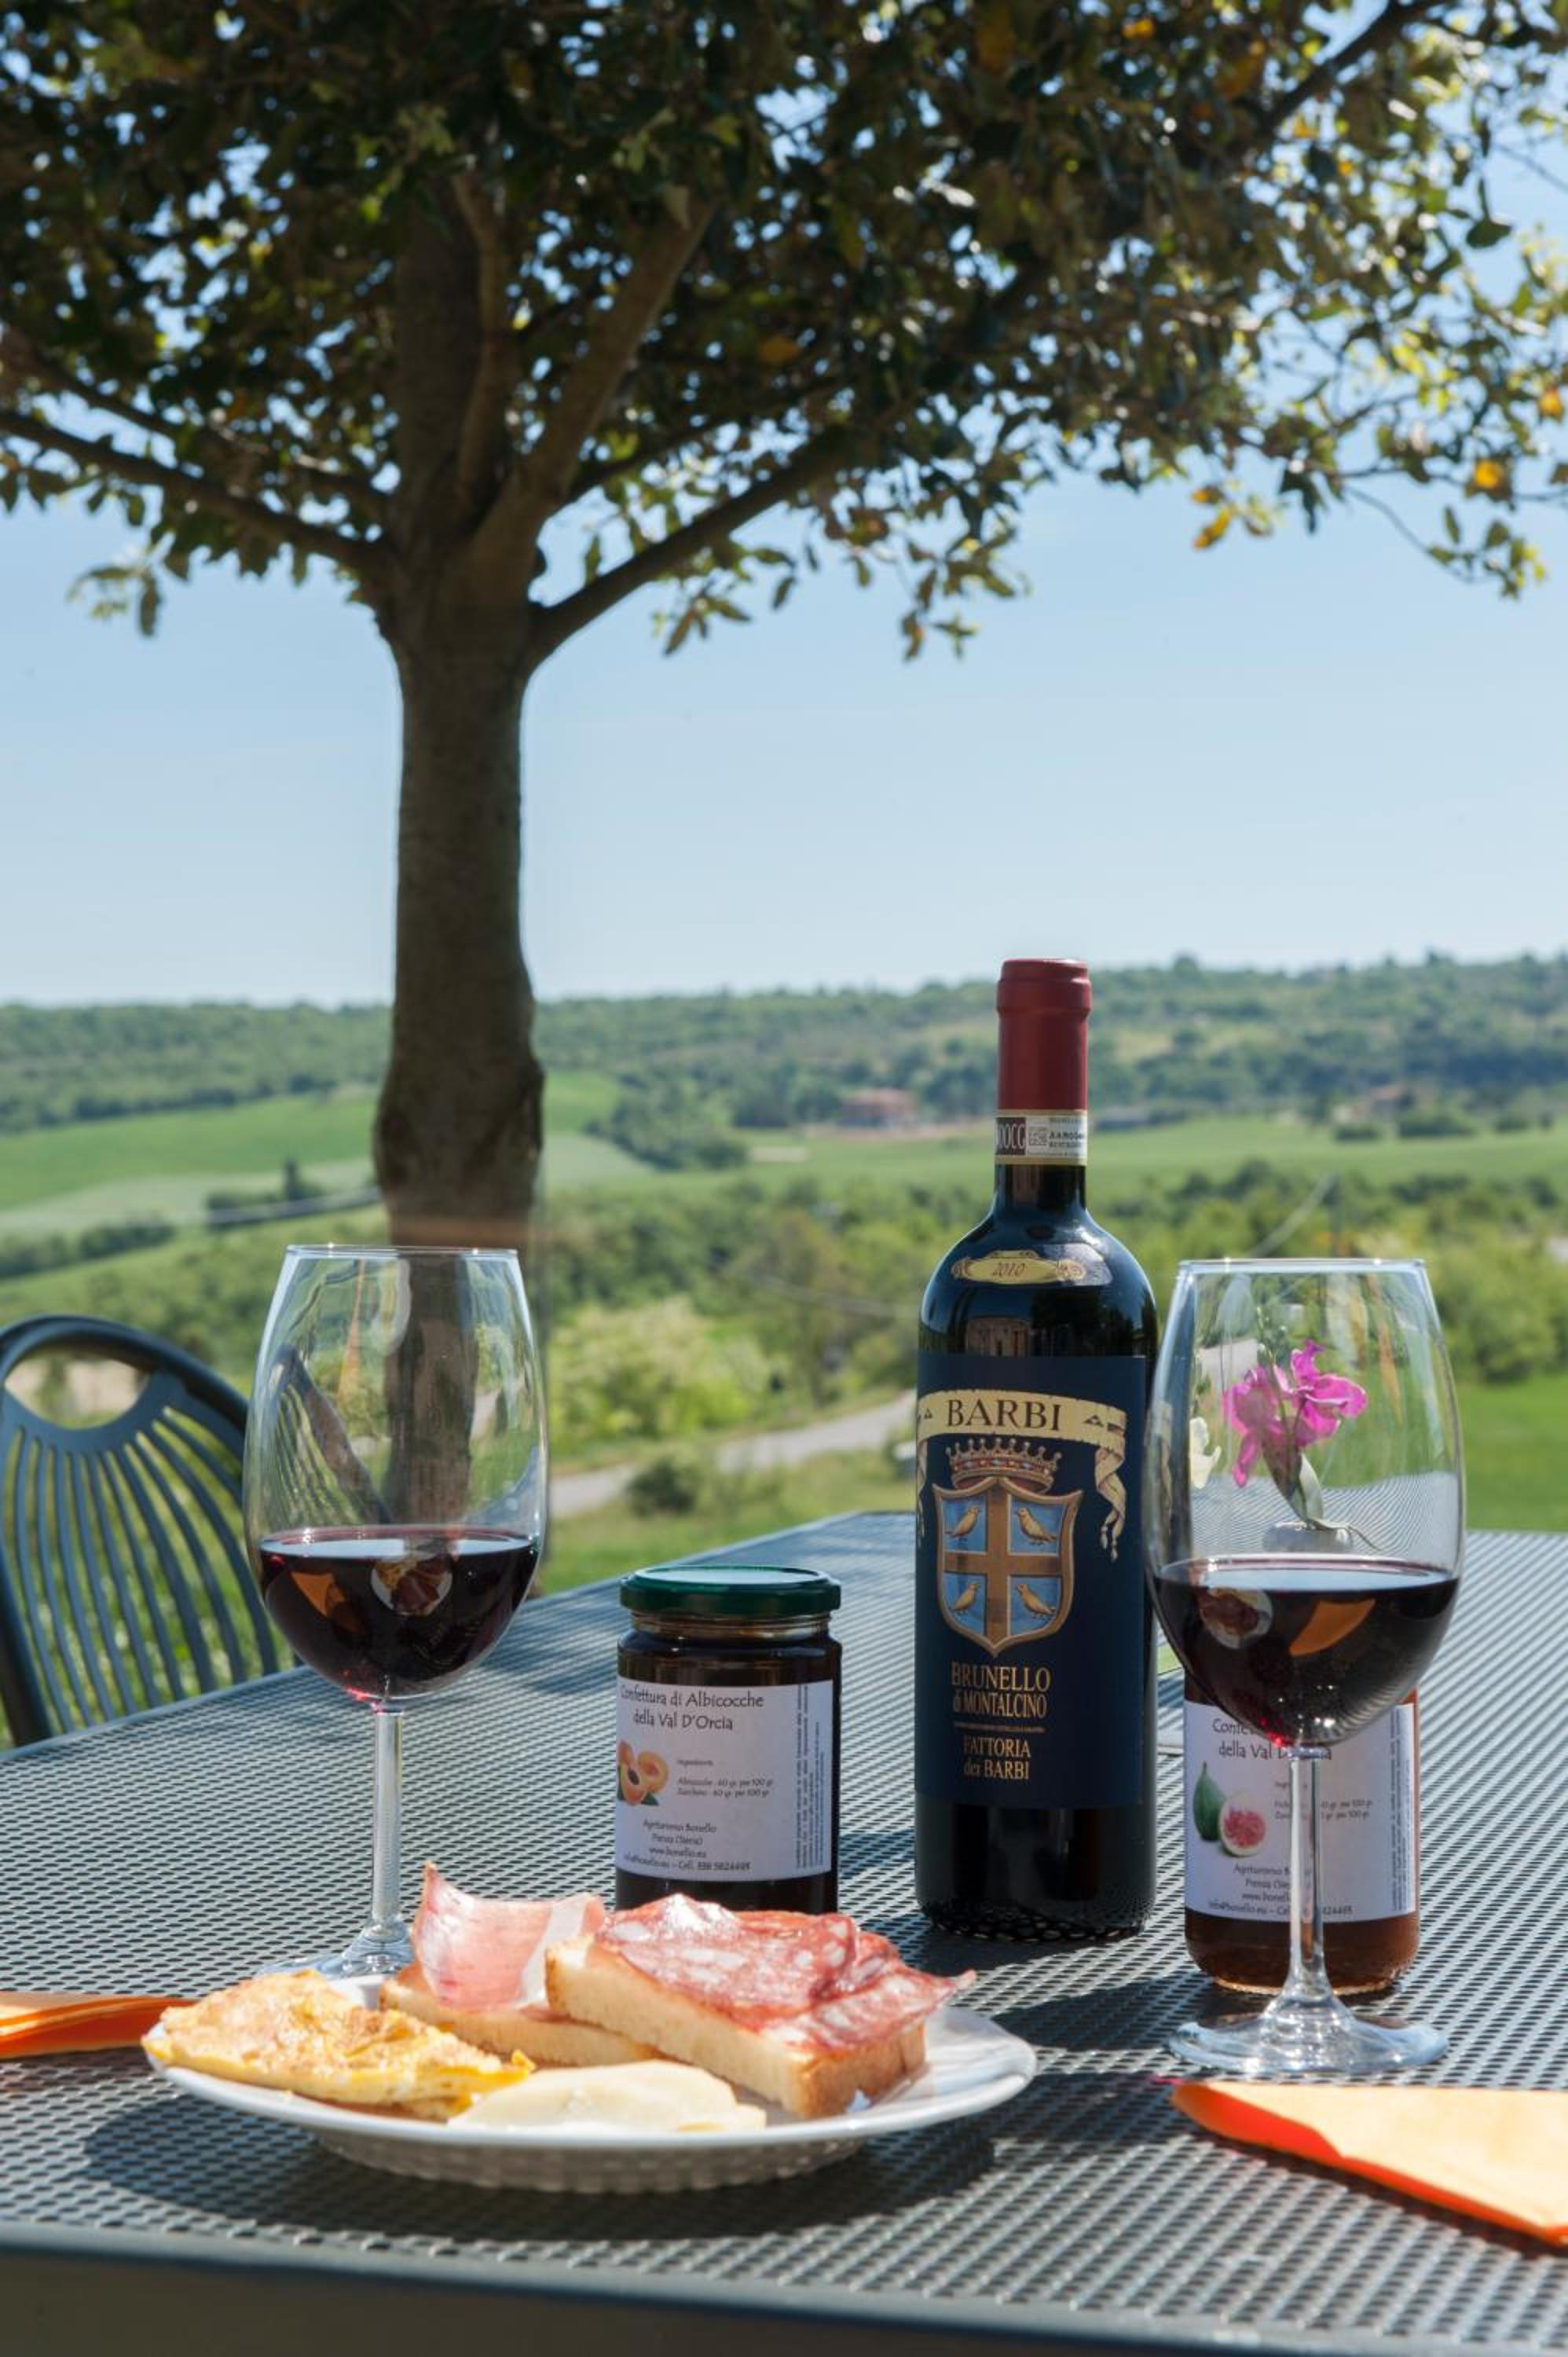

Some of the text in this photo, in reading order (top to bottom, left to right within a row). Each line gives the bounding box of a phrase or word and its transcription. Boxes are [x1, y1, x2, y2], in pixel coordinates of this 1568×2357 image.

[991, 1262, 1025, 1277] 2010
[946, 1398, 1062, 1431] BARBI
[951, 1660, 1052, 1692] BRUNELLO
[670, 1690, 682, 1707] di
[685, 1690, 764, 1708] Albicocche
[963, 1690, 1048, 1719] MONTALCINO
[633, 1709, 734, 1732] della Val D'Orcia
[963, 1735, 1031, 1758] FATTORIA
[1218, 1740, 1247, 1758] della
[1250, 1742, 1272, 1761] Val
[984, 1759, 1031, 1780] BARBI
